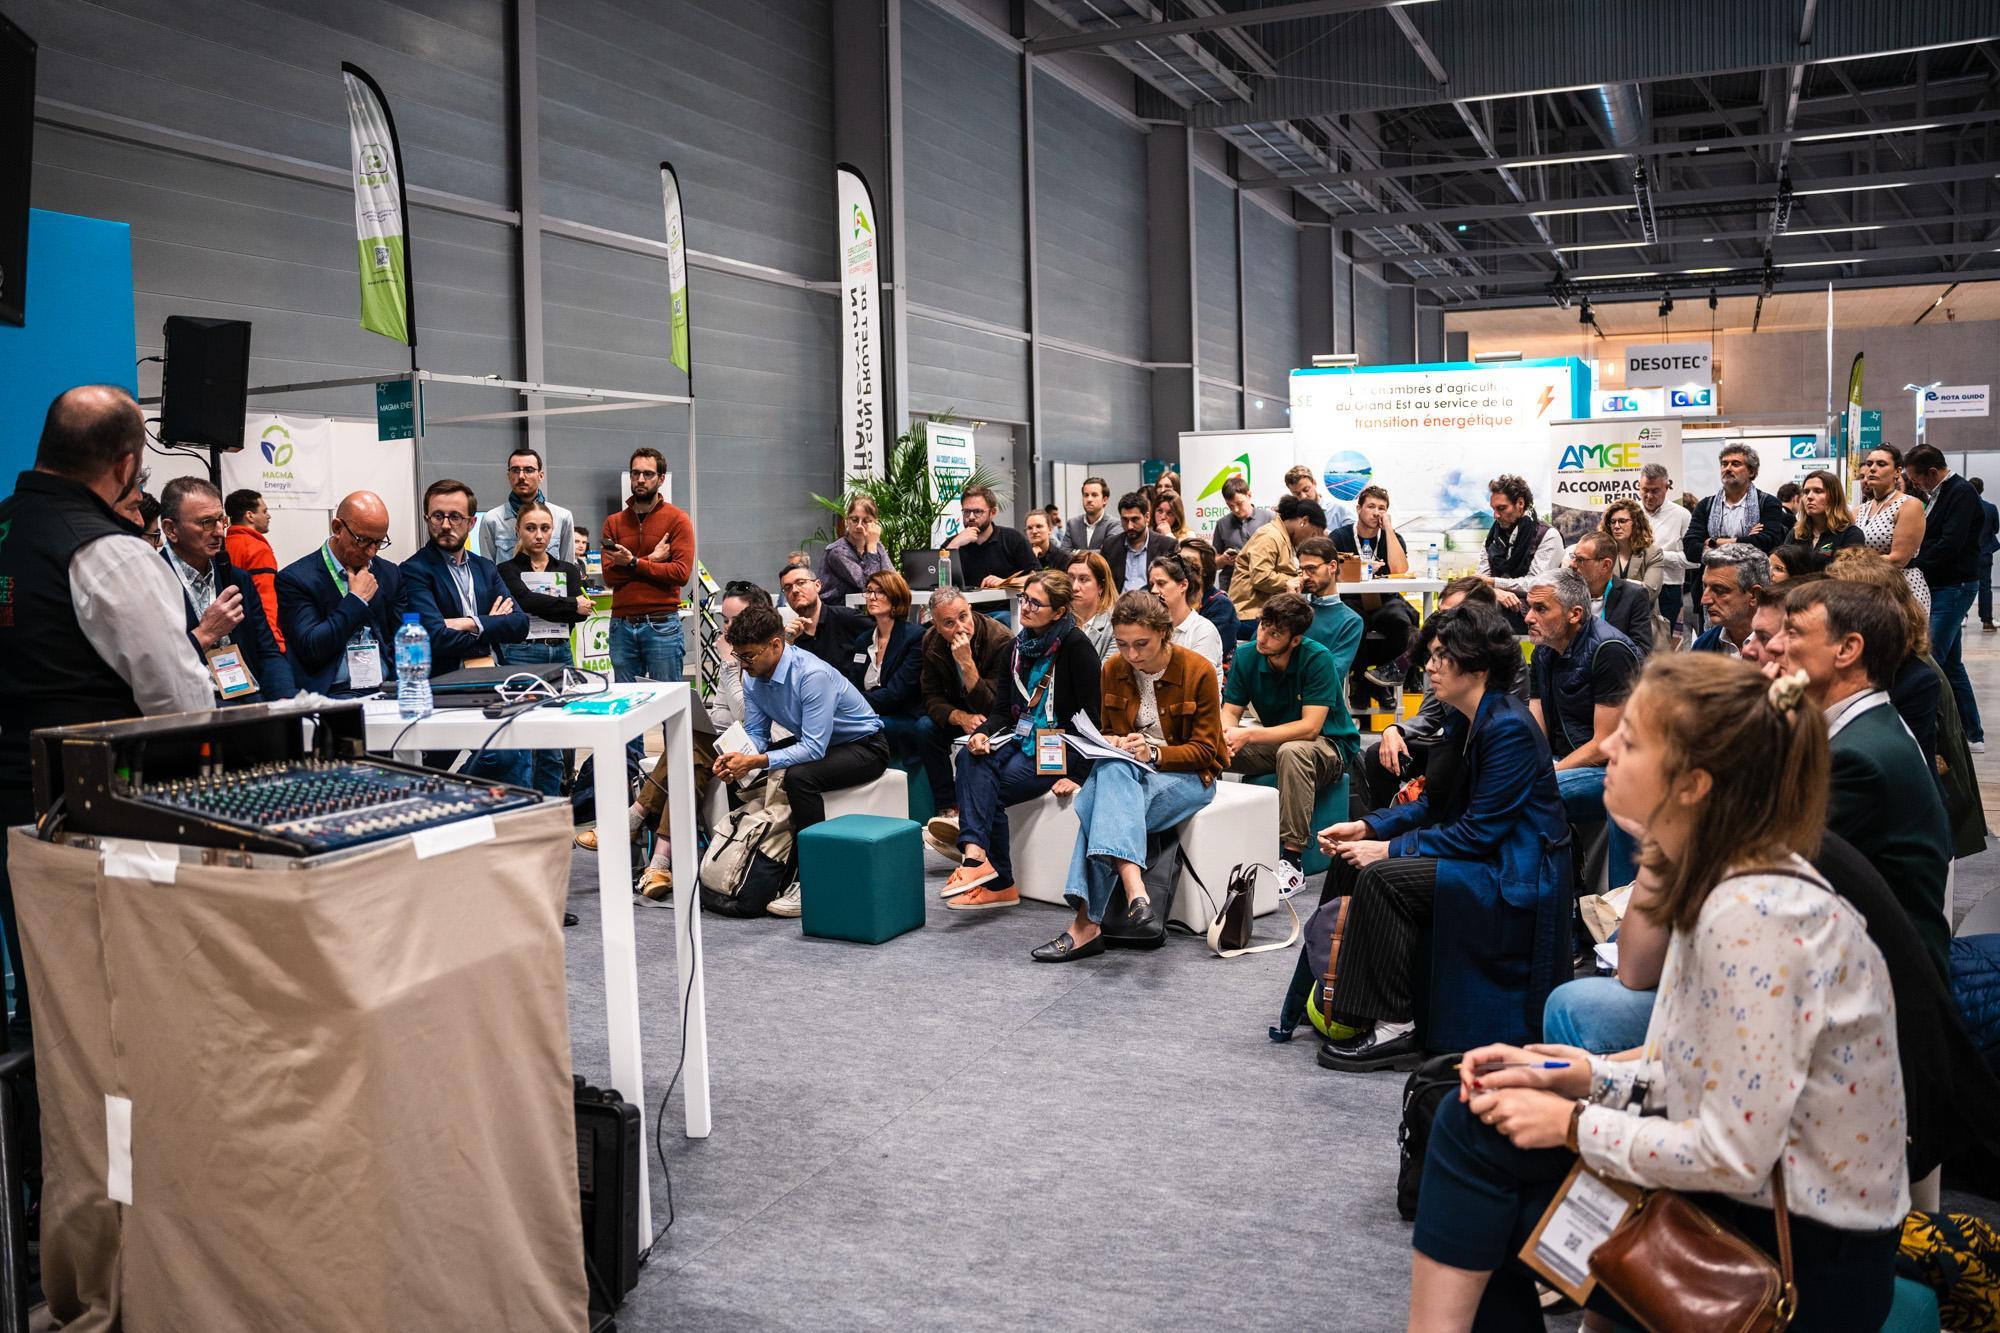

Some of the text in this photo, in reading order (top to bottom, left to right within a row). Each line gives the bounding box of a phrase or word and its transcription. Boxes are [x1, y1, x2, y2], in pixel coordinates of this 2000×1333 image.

[1355, 400, 1392, 411] Grand
[1396, 399, 1411, 410] Est
[1415, 400, 1430, 410] au
[1434, 397, 1478, 409] service
[1482, 397, 1498, 408] de
[1502, 396, 1513, 407] la
[1603, 397, 1637, 412] CIC
[1674, 390, 1708, 406] CIC
[1355, 413, 1513, 430] transition énergétique
[1557, 442, 1641, 470] AMGE
[262, 471, 294, 480] MAGMA
